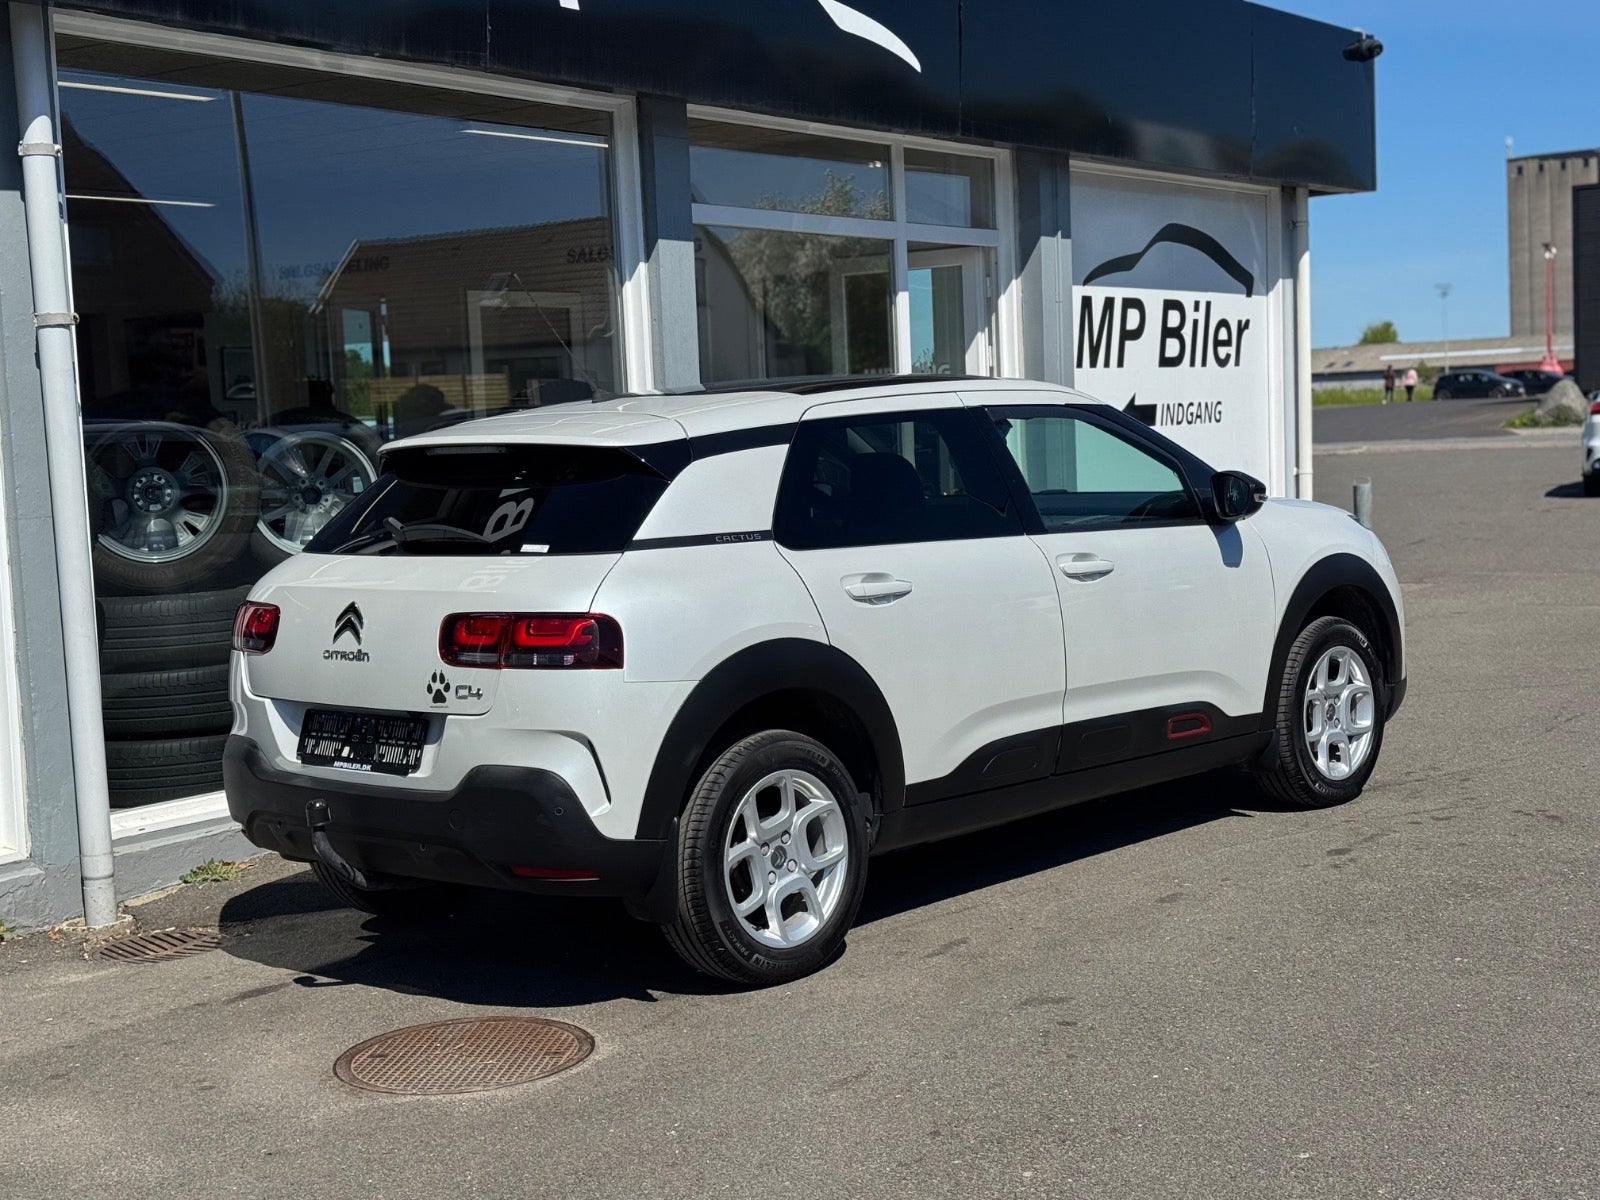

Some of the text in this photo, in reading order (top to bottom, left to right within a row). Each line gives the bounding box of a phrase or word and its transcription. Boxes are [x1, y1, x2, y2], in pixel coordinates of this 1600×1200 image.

[1076, 295, 1250, 369] MP Biler
[1160, 401, 1222, 426] INDGANG
[715, 533, 762, 542] CACTUS
[455, 685, 483, 700] C4
